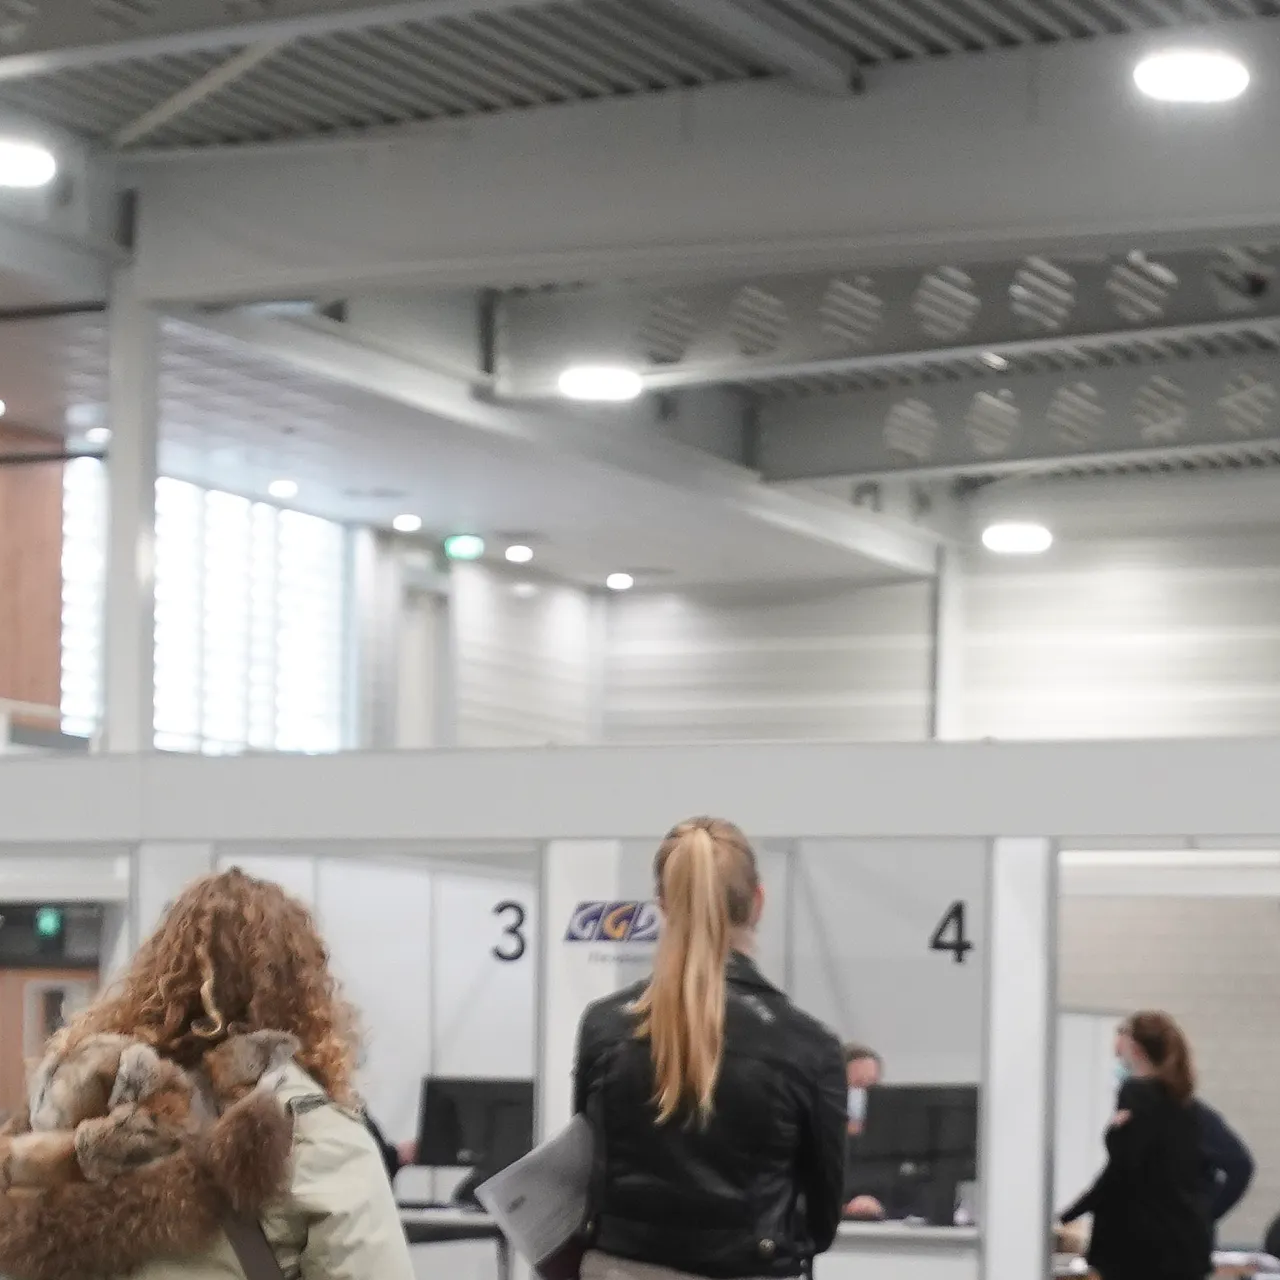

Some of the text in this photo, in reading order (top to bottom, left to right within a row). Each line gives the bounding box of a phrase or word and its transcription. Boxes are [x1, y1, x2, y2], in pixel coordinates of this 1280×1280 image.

[493, 901, 526, 961] 3
[564, 900, 663, 941] GGD
[930, 900, 972, 962] 4
